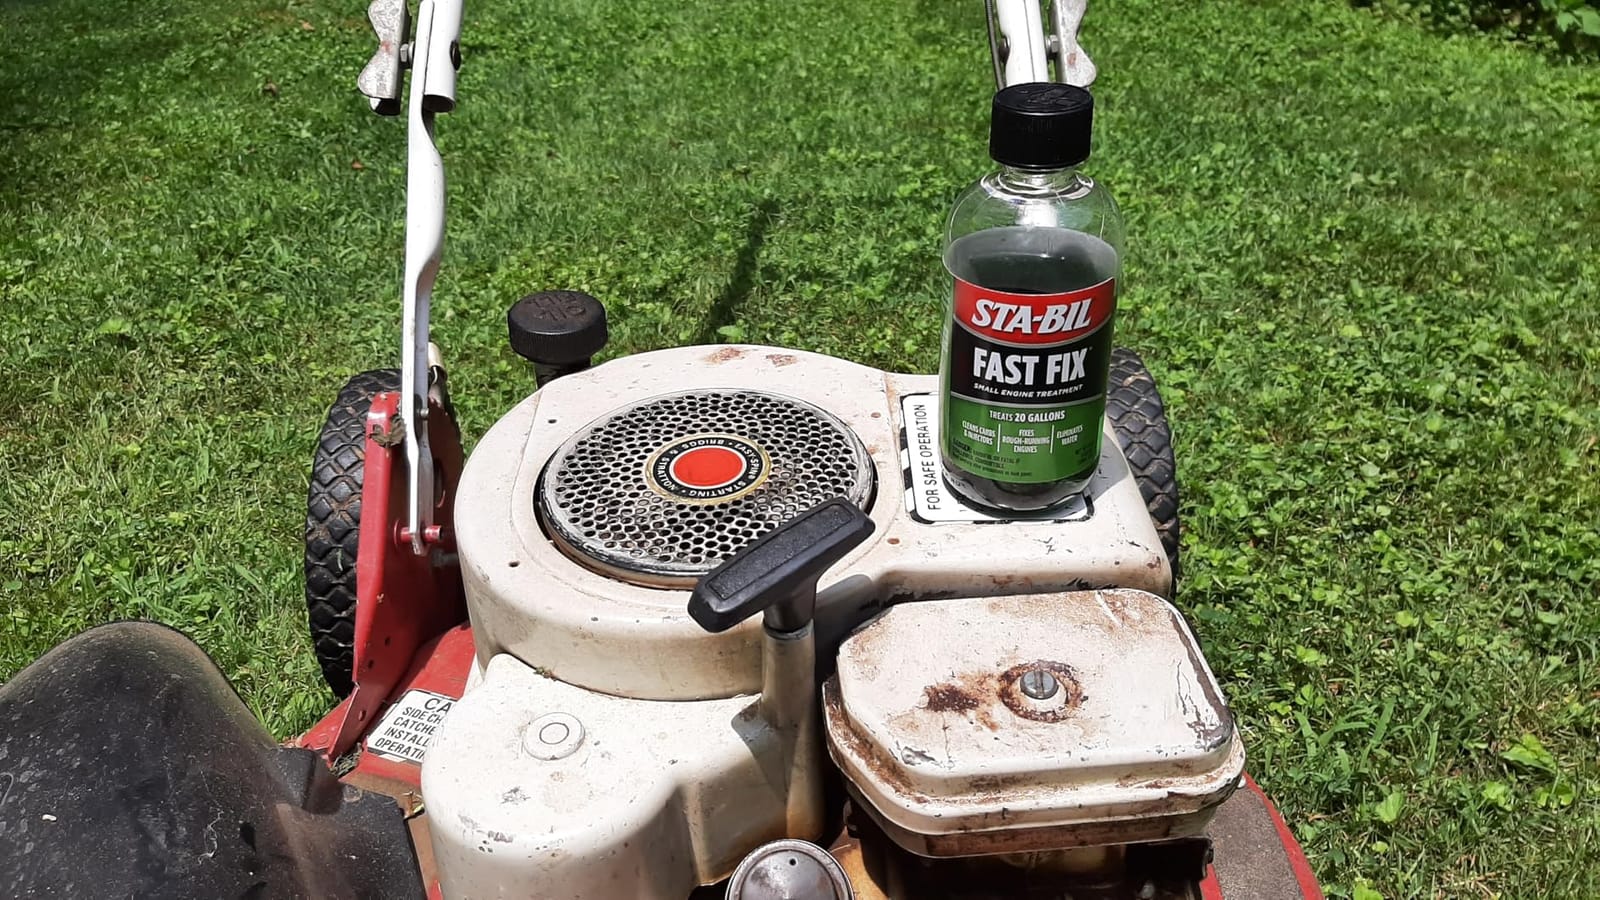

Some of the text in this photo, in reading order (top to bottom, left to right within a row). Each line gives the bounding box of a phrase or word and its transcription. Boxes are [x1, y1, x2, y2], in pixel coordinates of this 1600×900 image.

[971, 298, 1093, 334] STA-BIL
[973, 346, 1089, 386] FAST FIX
[973, 382, 1084, 398] SMALL ENGINE TREATMENT
[989, 410, 1066, 423] TREATS 20 GALLONS
[1018, 429, 1035, 437] FIXES
[681, 439, 725, 450] BRIGGS
[1013, 445, 1038, 453] ENGINES
[912, 404, 941, 511] FOR SAFE OPERATION
[657, 456, 680, 491] STRATTON
[688, 480, 747, 497] STARTING
[402, 706, 429, 720] SIDE
